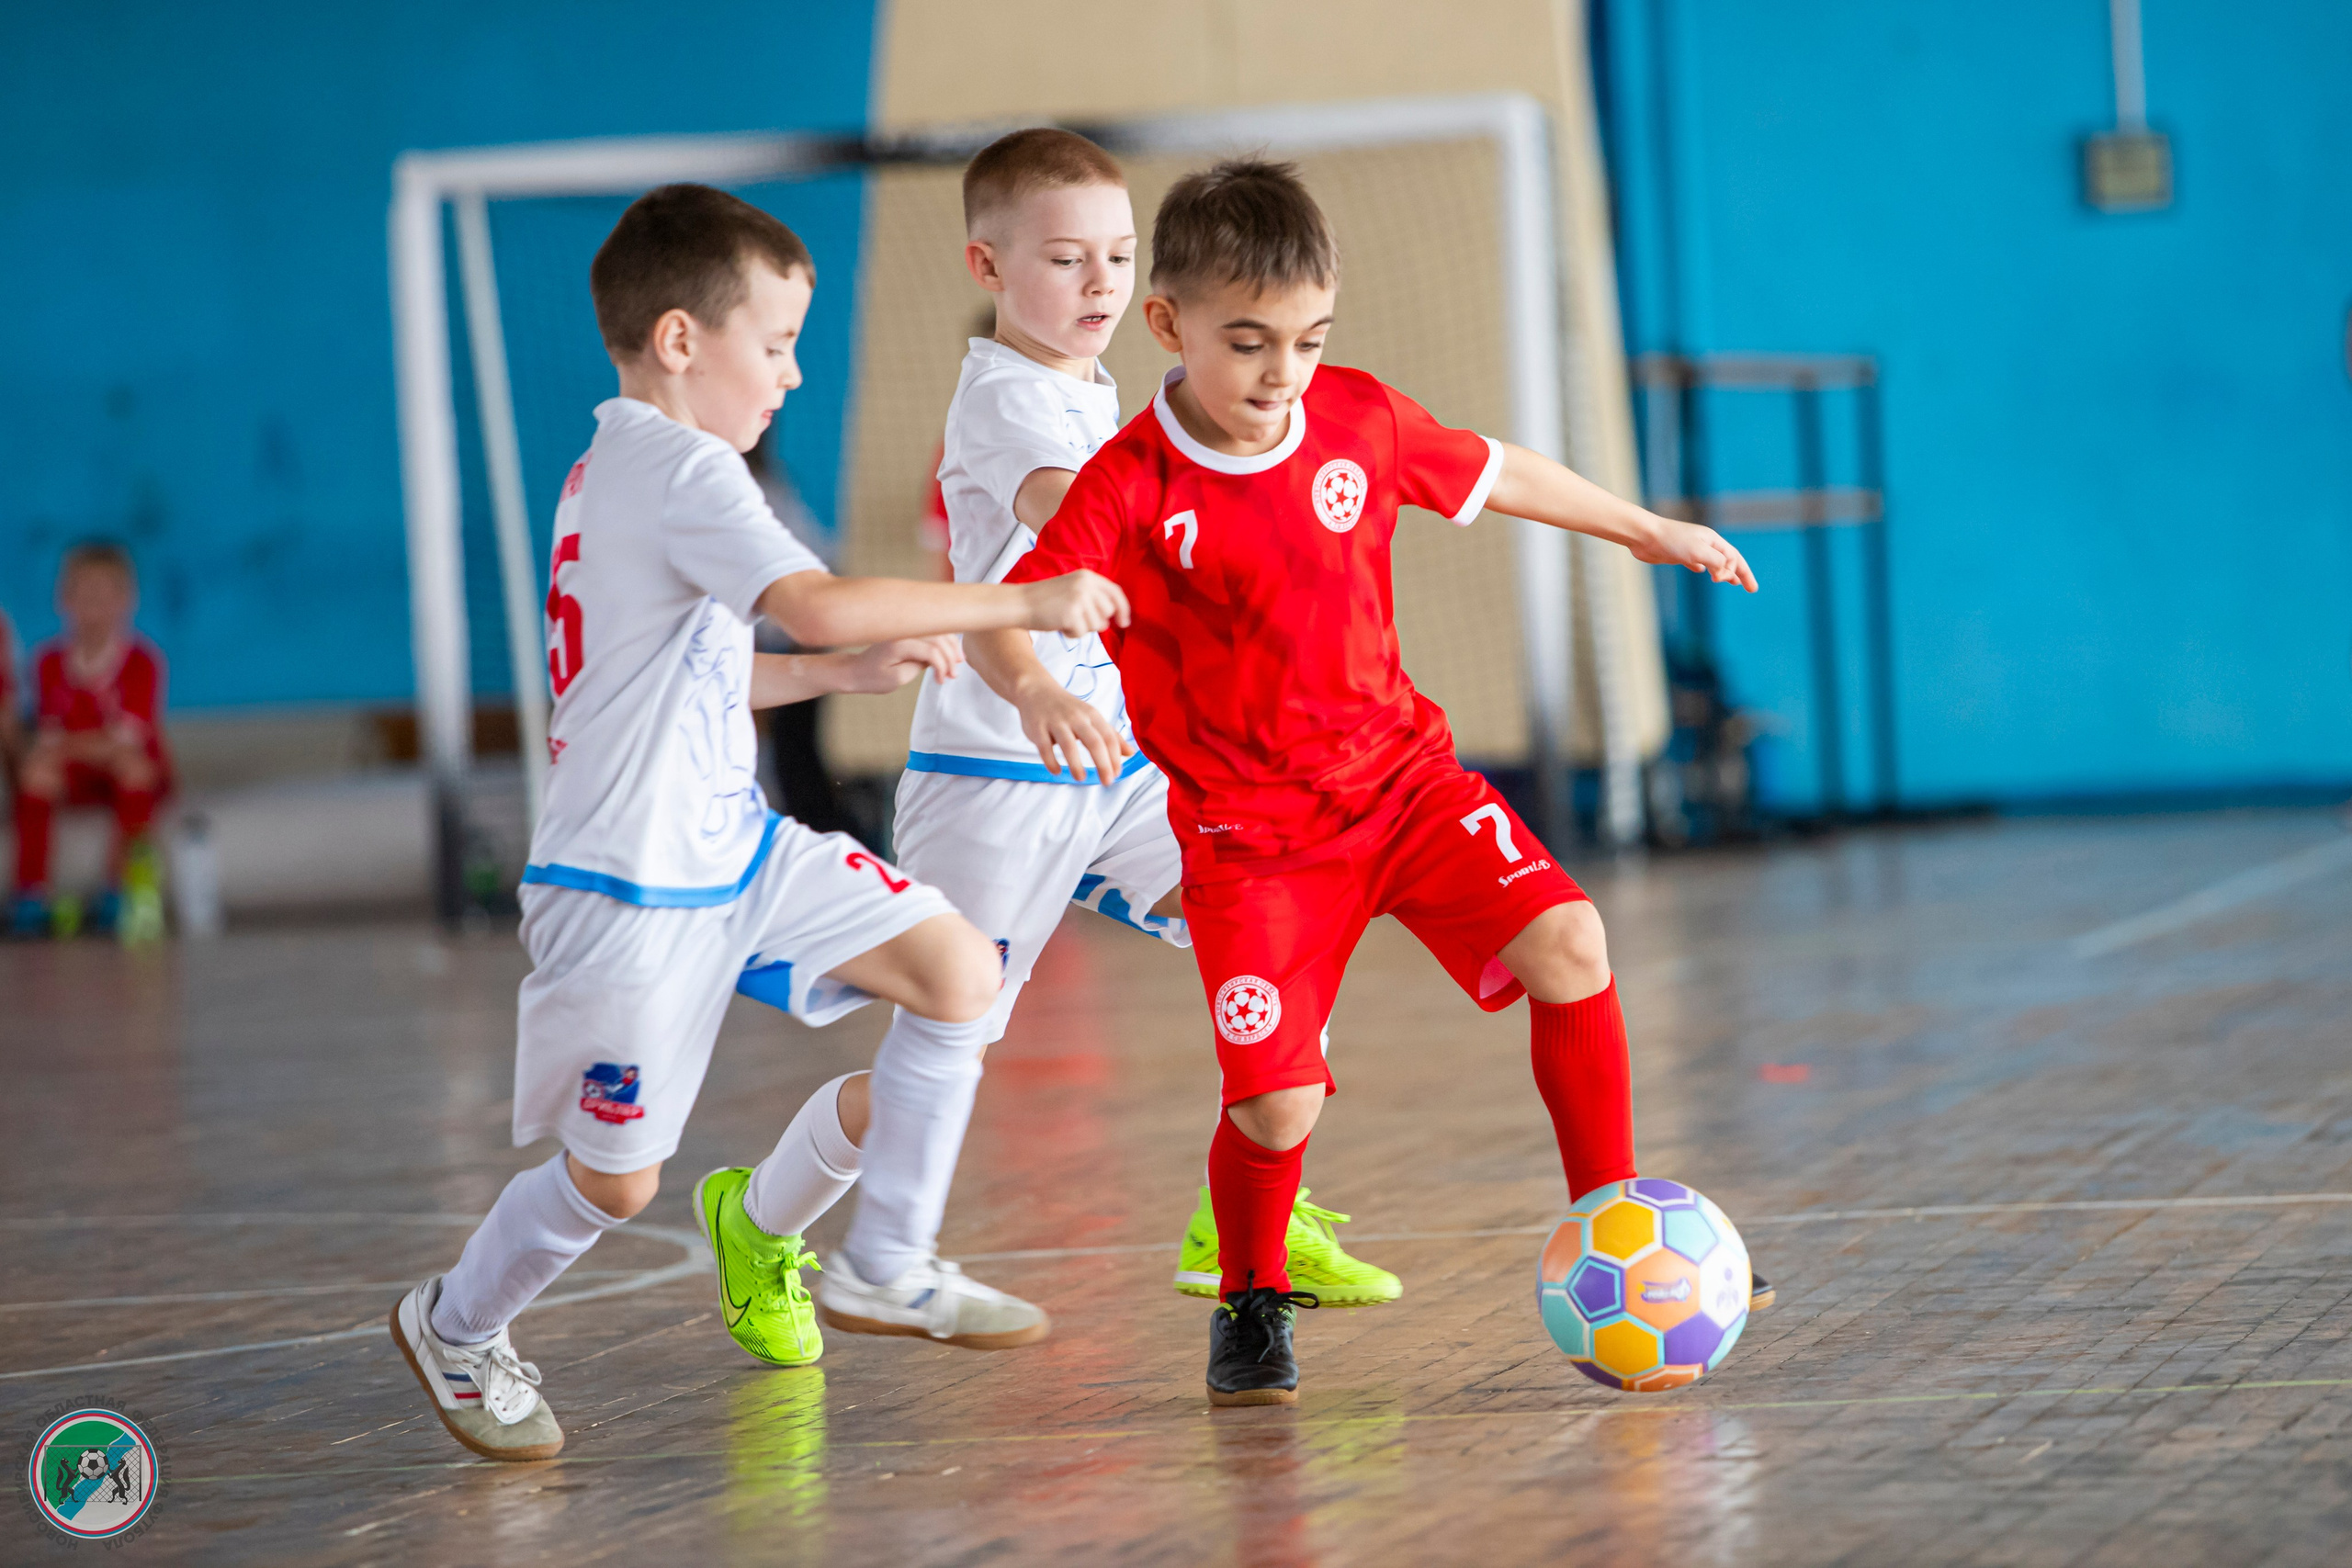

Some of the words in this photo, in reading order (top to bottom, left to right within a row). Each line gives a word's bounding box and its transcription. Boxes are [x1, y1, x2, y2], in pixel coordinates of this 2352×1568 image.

[1163, 509, 1198, 569] 7
[546, 532, 584, 697] 5
[1459, 803, 1523, 863] 7
[846, 852, 911, 894] 2
